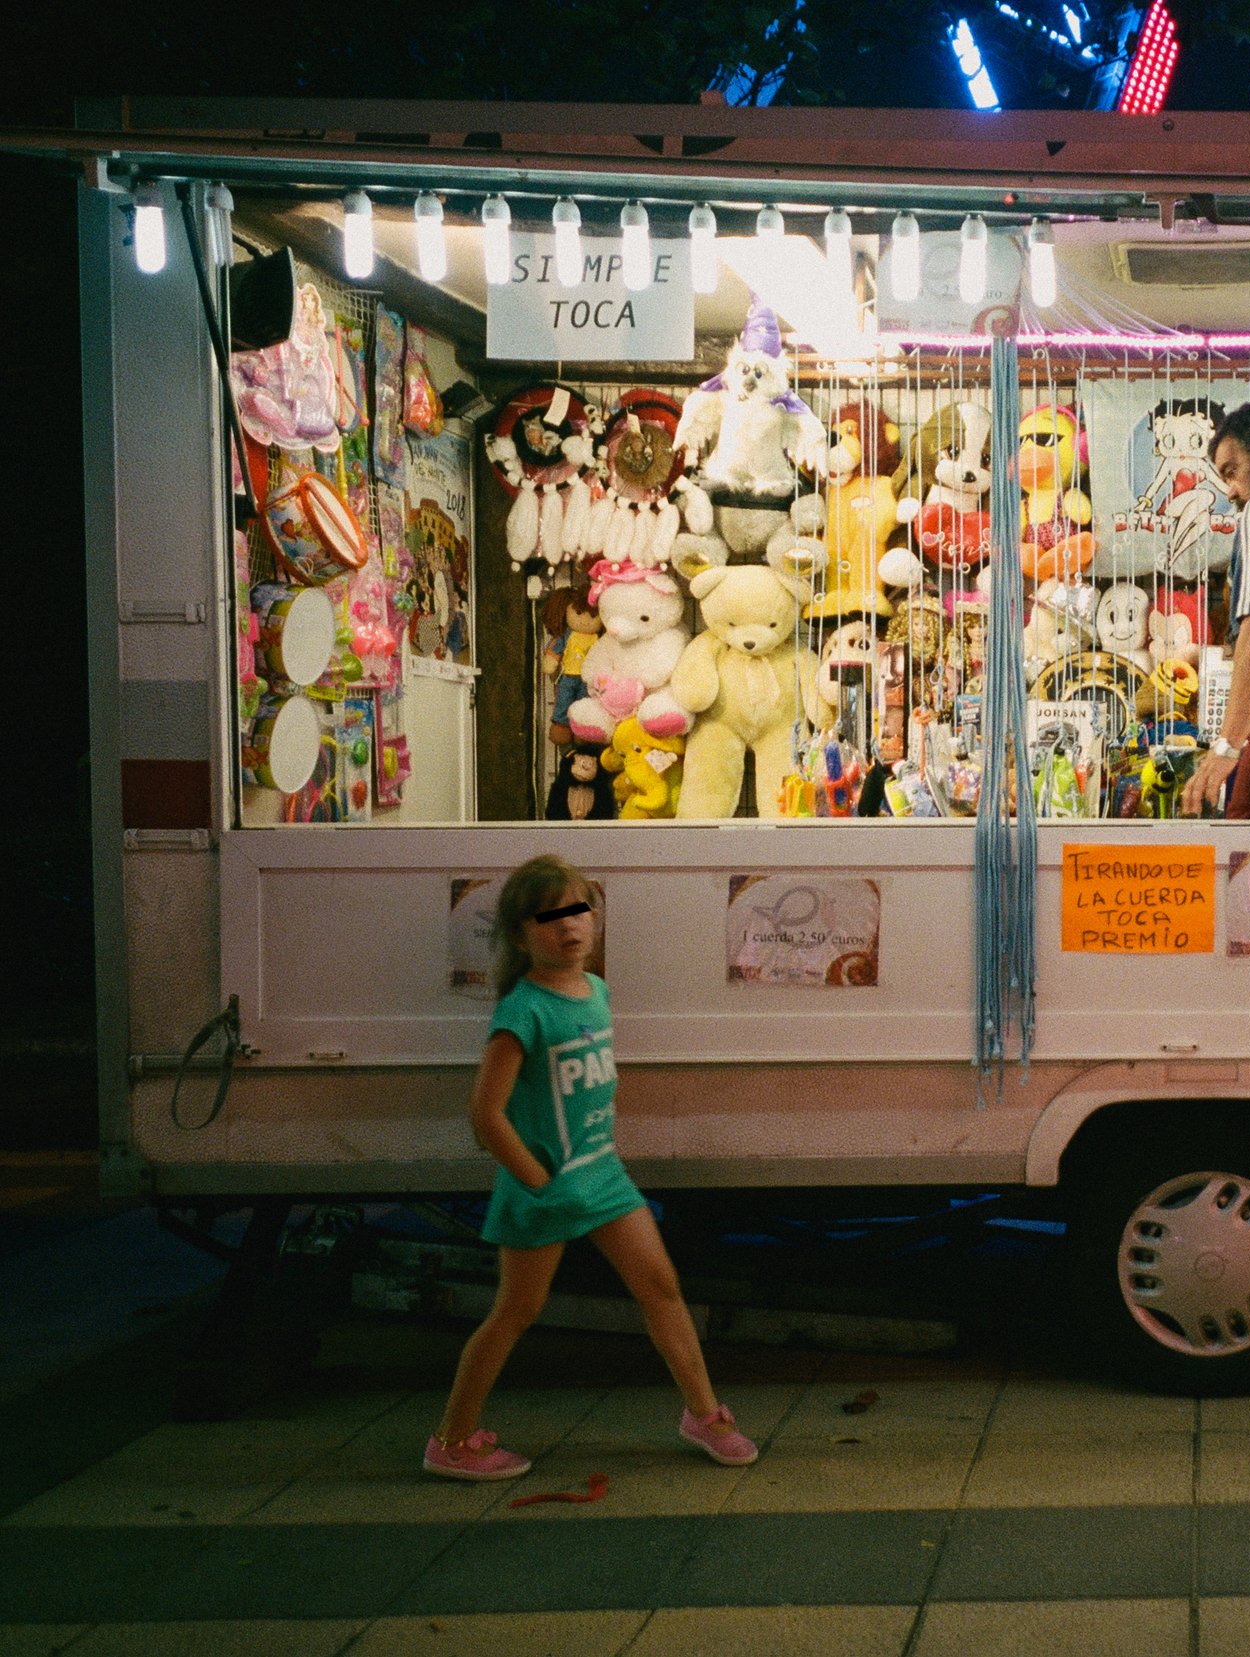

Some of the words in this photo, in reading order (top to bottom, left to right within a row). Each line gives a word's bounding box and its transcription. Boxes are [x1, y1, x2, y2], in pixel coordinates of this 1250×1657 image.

[511, 254, 673, 283] SIMPE
[549, 300, 636, 328] TOCA
[1037, 708, 1087, 718] JORSAN
[1077, 890, 1105, 908] LA
[1115, 887, 1206, 907] CUERDA
[1097, 909, 1171, 926] TOCA
[753, 930, 795, 943] cuerda
[831, 935, 866, 946] euros
